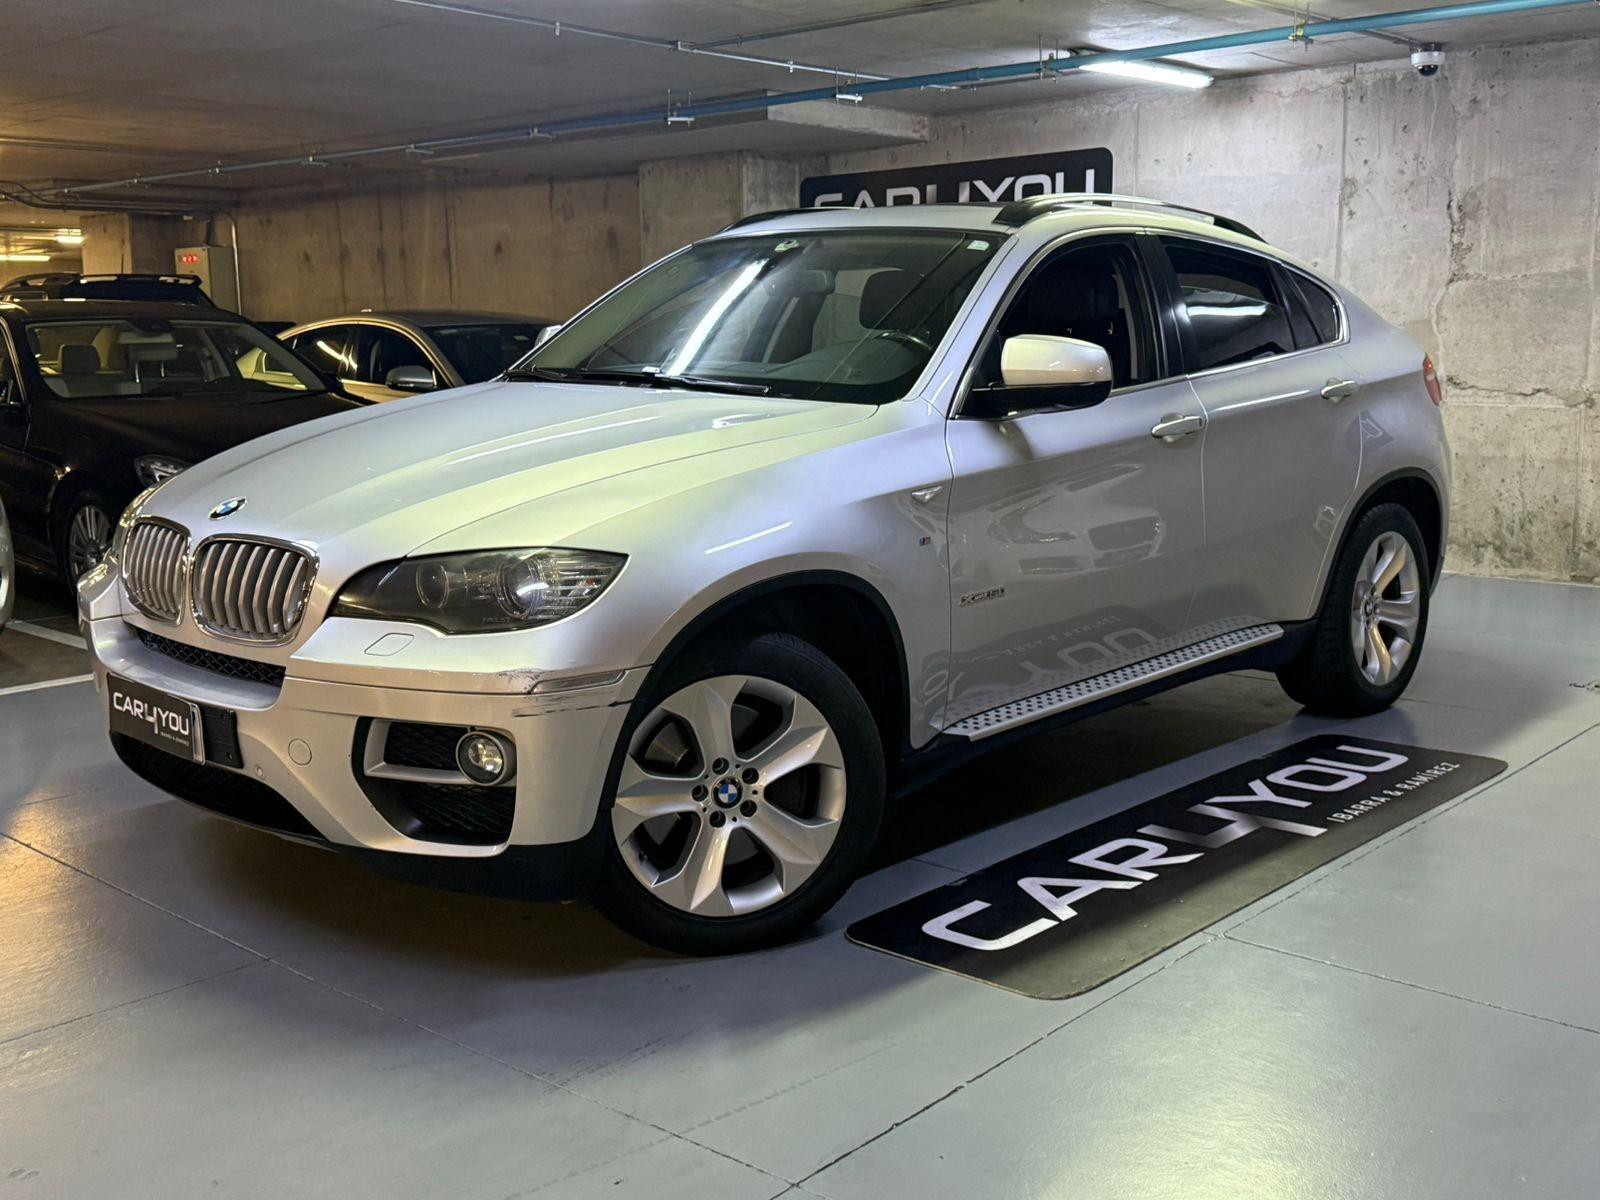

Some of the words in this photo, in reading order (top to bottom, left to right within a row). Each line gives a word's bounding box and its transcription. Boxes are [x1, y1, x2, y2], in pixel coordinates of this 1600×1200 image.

[113, 692, 190, 735] CAR4YOU
[1326, 796, 1390, 823] IBARRA
[921, 745, 1409, 951] CAR4YOU
